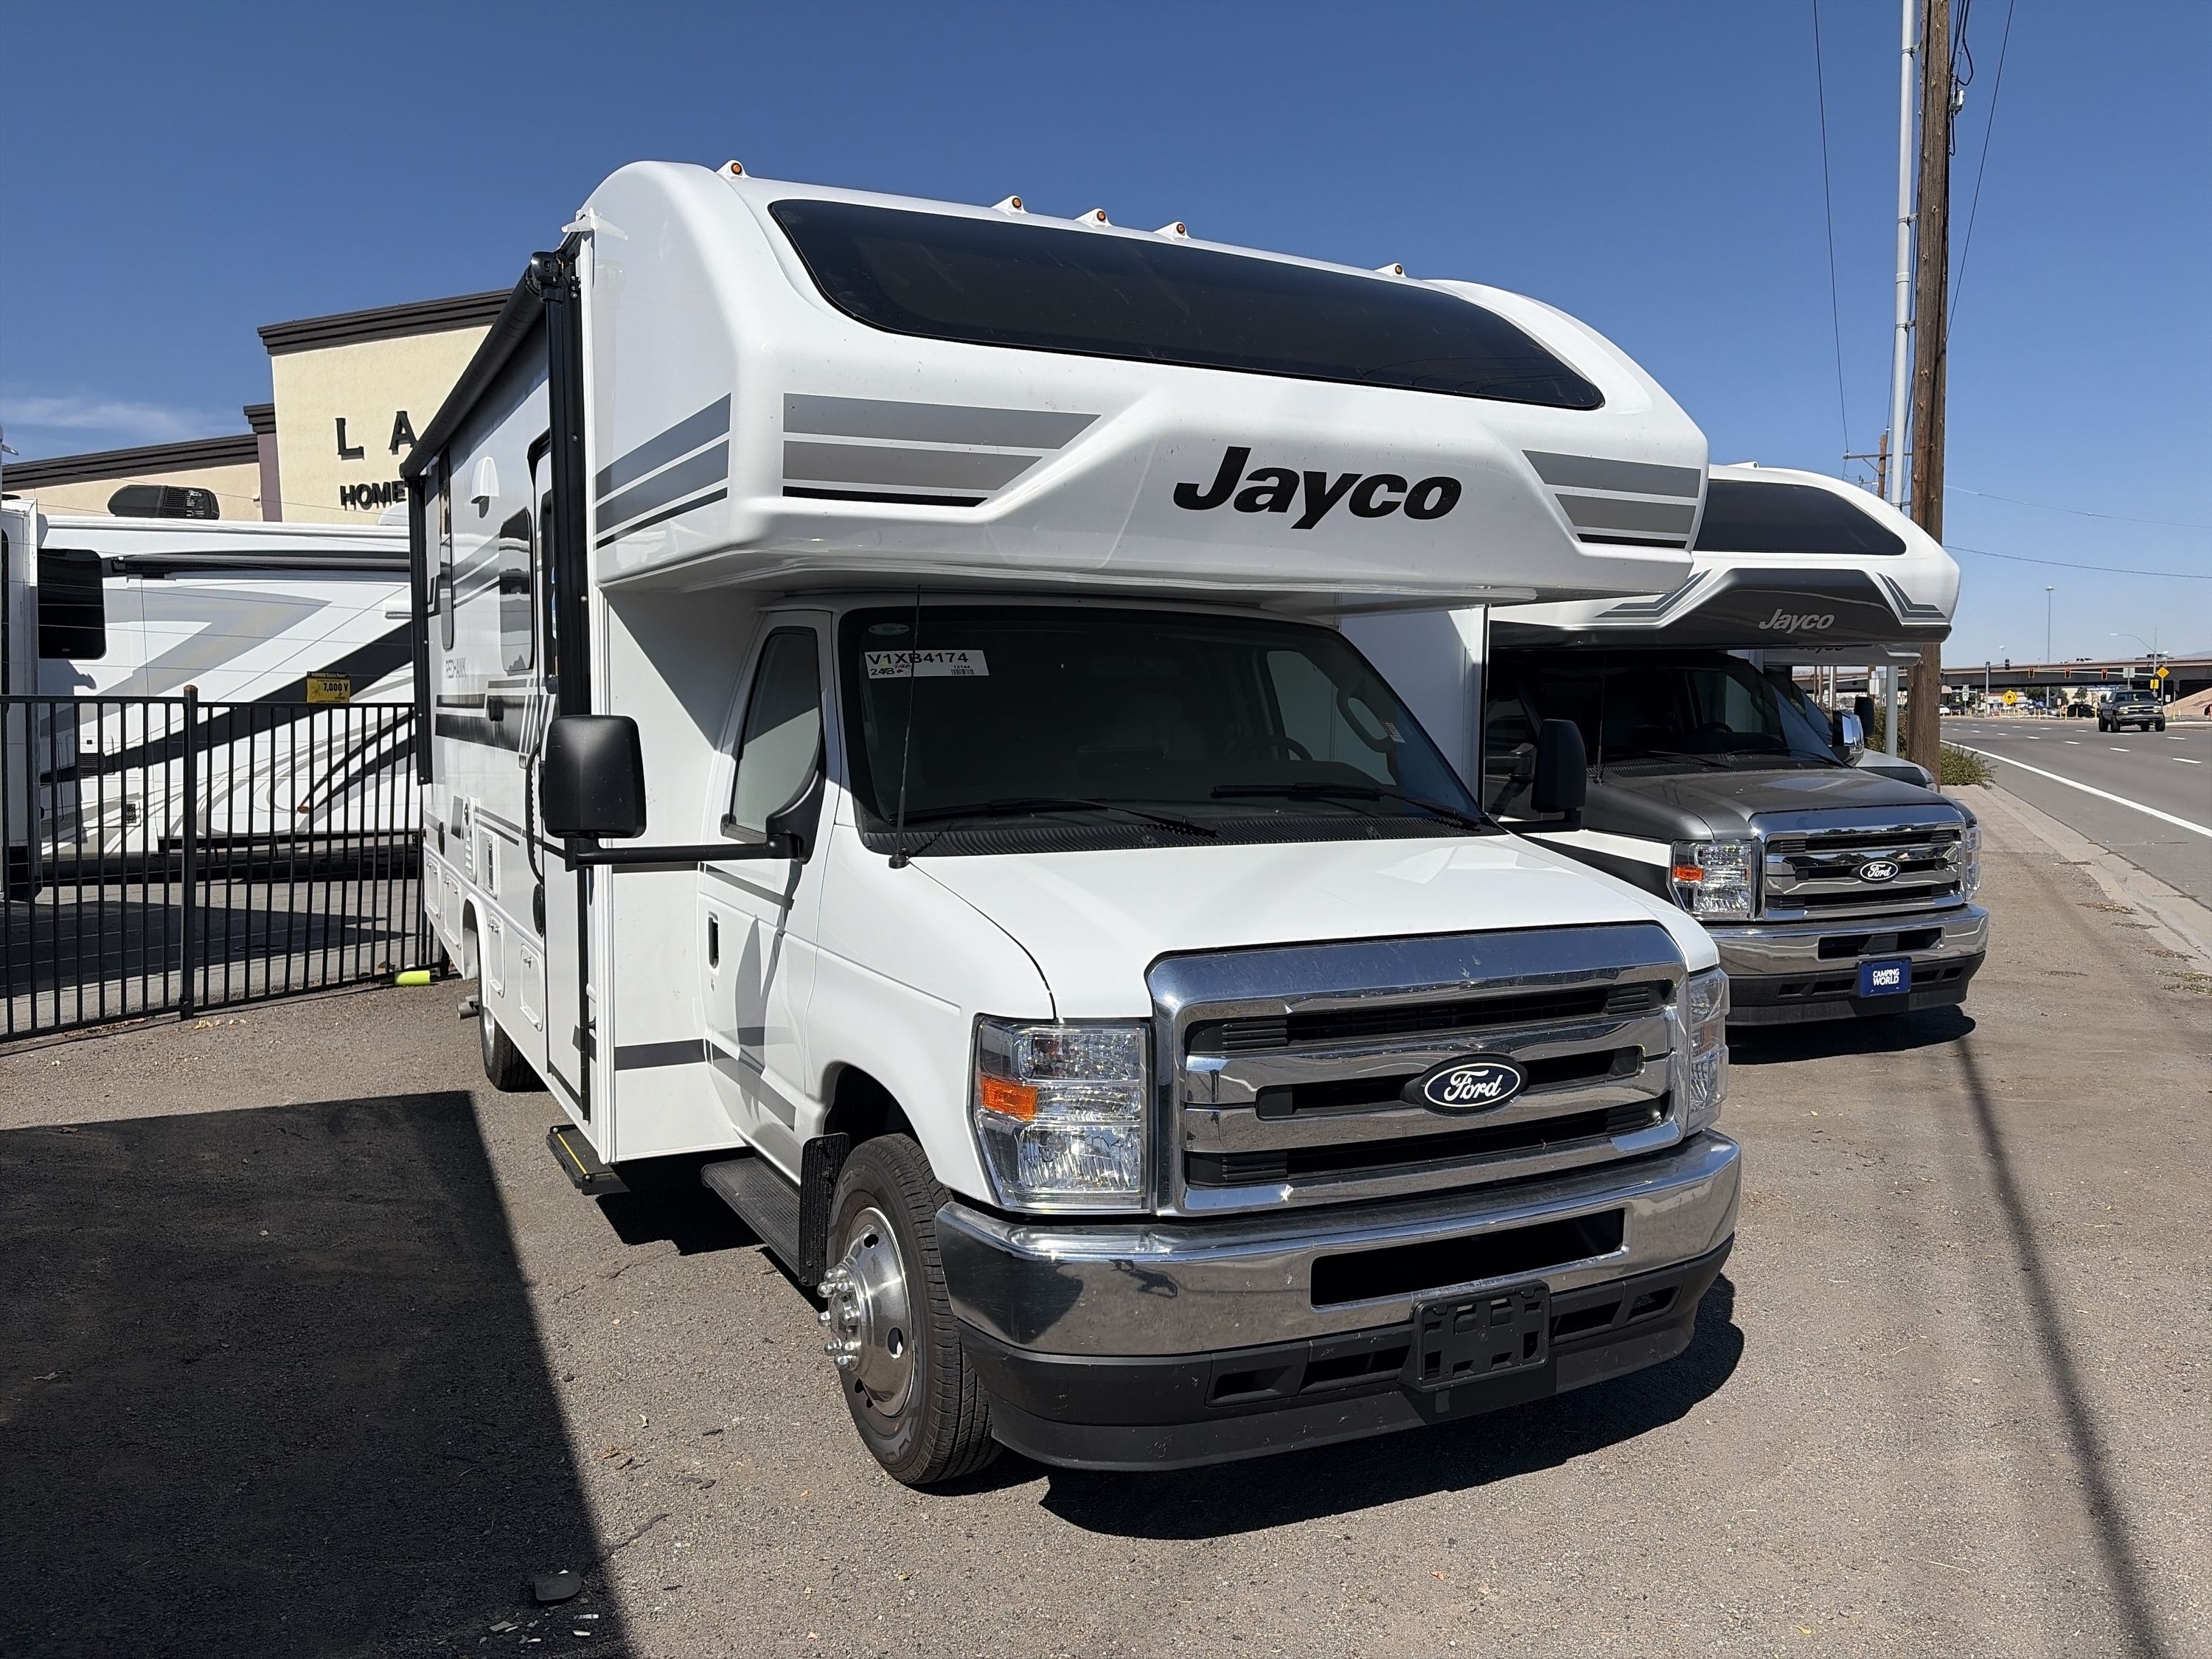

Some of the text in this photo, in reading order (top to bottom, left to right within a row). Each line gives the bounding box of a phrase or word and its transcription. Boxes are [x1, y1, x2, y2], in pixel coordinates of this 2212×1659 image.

[340, 481, 406, 509] HOME
[1173, 446, 1462, 529] Jayco
[1759, 608, 1834, 633] Jayco
[867, 652, 969, 665] V1XB4174
[323, 683, 349, 692] 7,000 V
[1867, 863, 1891, 878] Ford
[1873, 968, 1899, 978] CAMPING
[1873, 976, 1899, 986] WORLD
[1443, 1069, 1503, 1102] Ford
